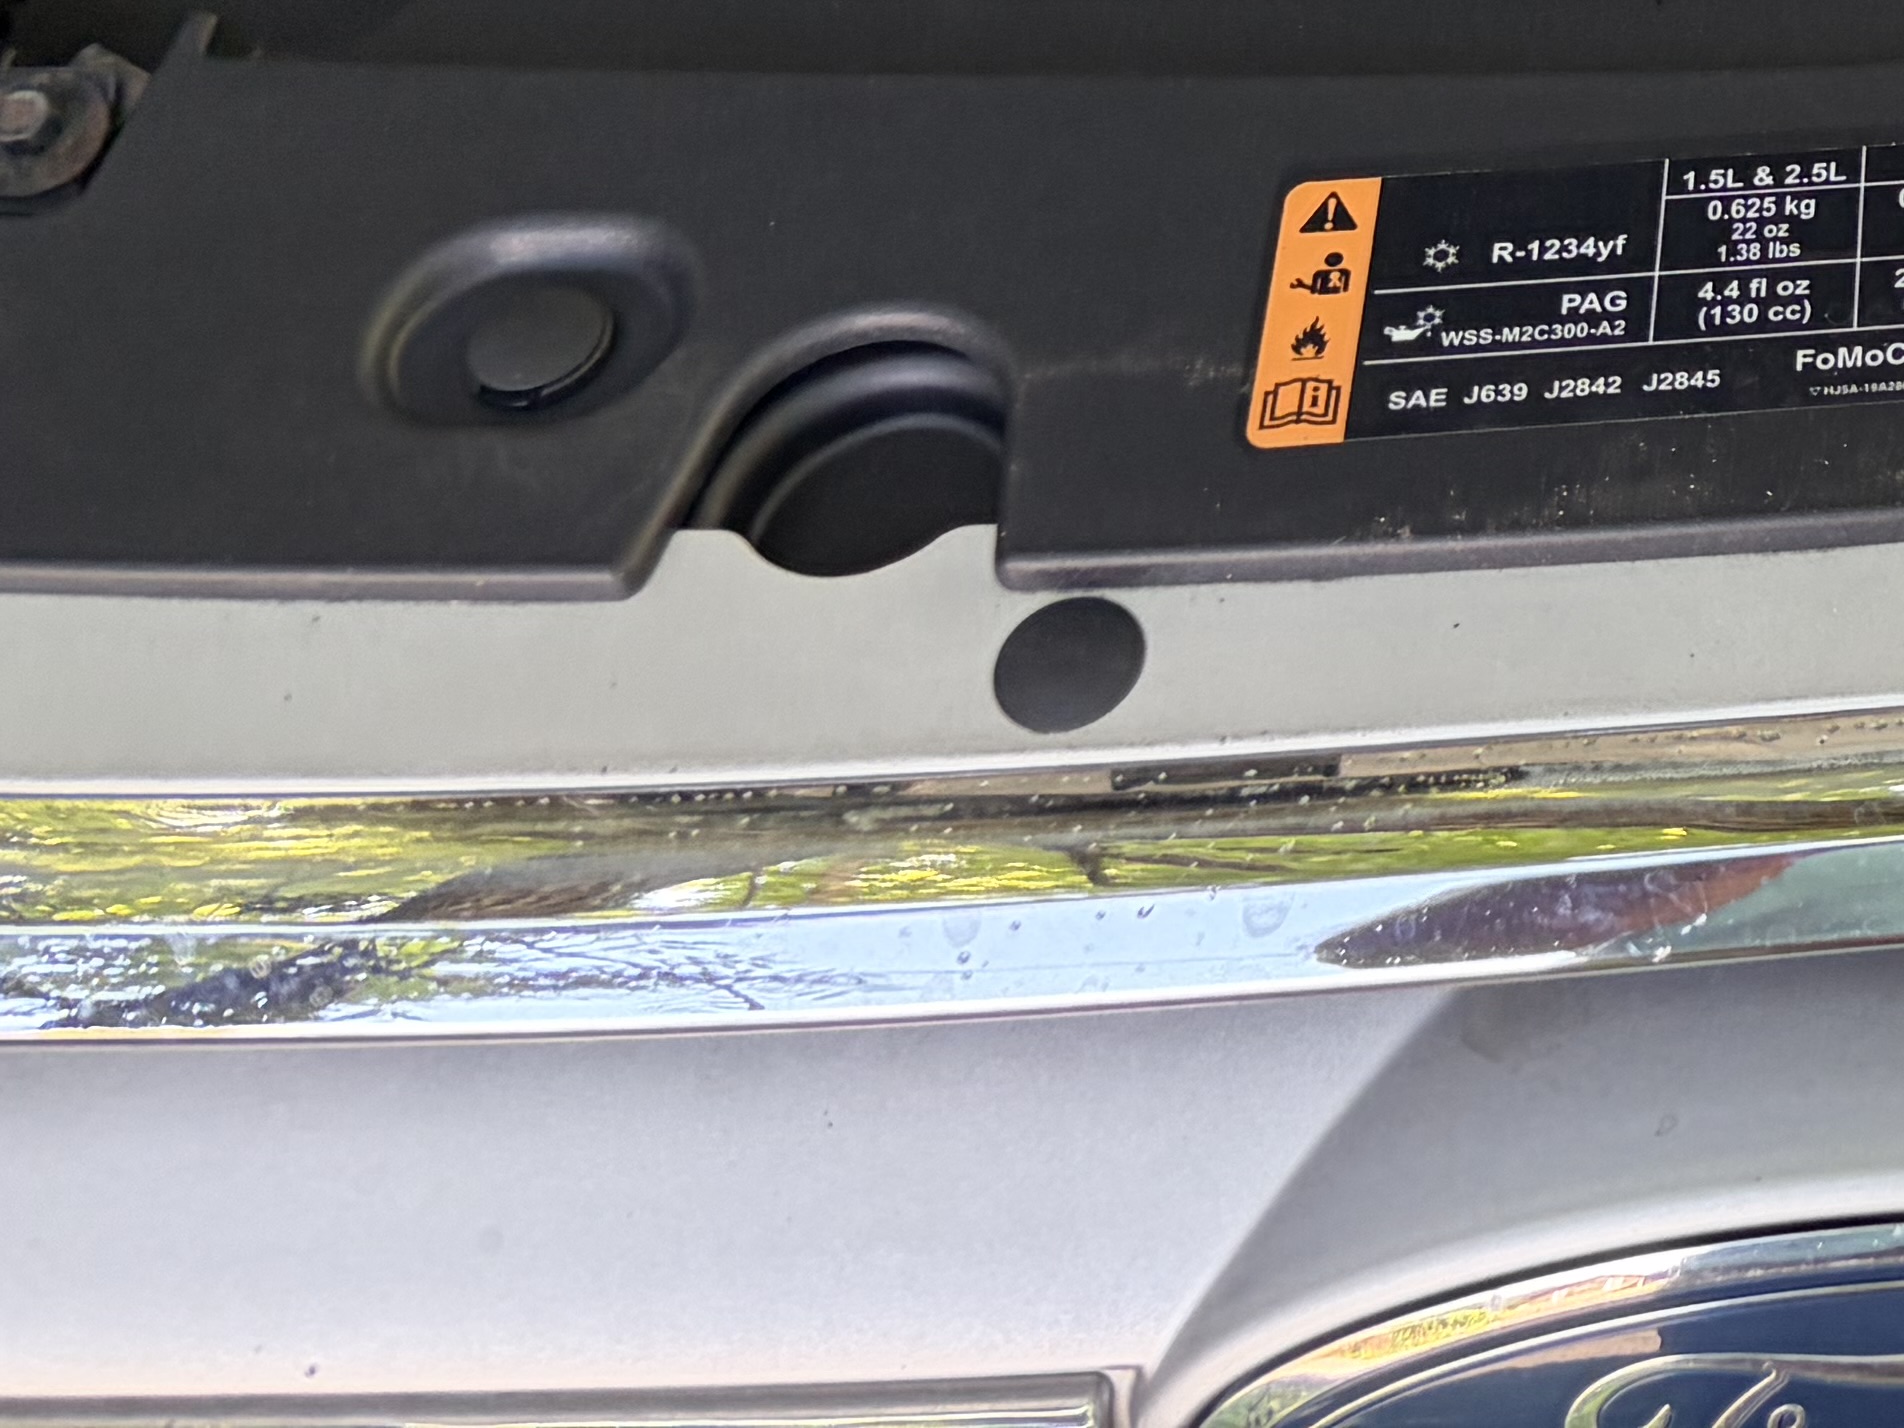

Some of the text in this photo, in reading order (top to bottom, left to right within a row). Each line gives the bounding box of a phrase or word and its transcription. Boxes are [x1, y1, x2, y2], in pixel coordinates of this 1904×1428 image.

[1682, 161, 1847, 191] 1.5L & 2.5L
[1707, 195, 1816, 220] 0.625 kg
[1730, 222, 1790, 241] 22 oz
[1491, 234, 1628, 264] R-1234yf
[1717, 241, 1801, 263] 1.38 lbs
[1697, 278, 1811, 301] 4.4 fl oz
[1560, 291, 1628, 315] PAG
[1698, 299, 1812, 331] (130 cc)
[1440, 320, 1626, 347] WSS-M2C300-A2
[1388, 369, 1720, 410] SAE J639 J2842 J2845
